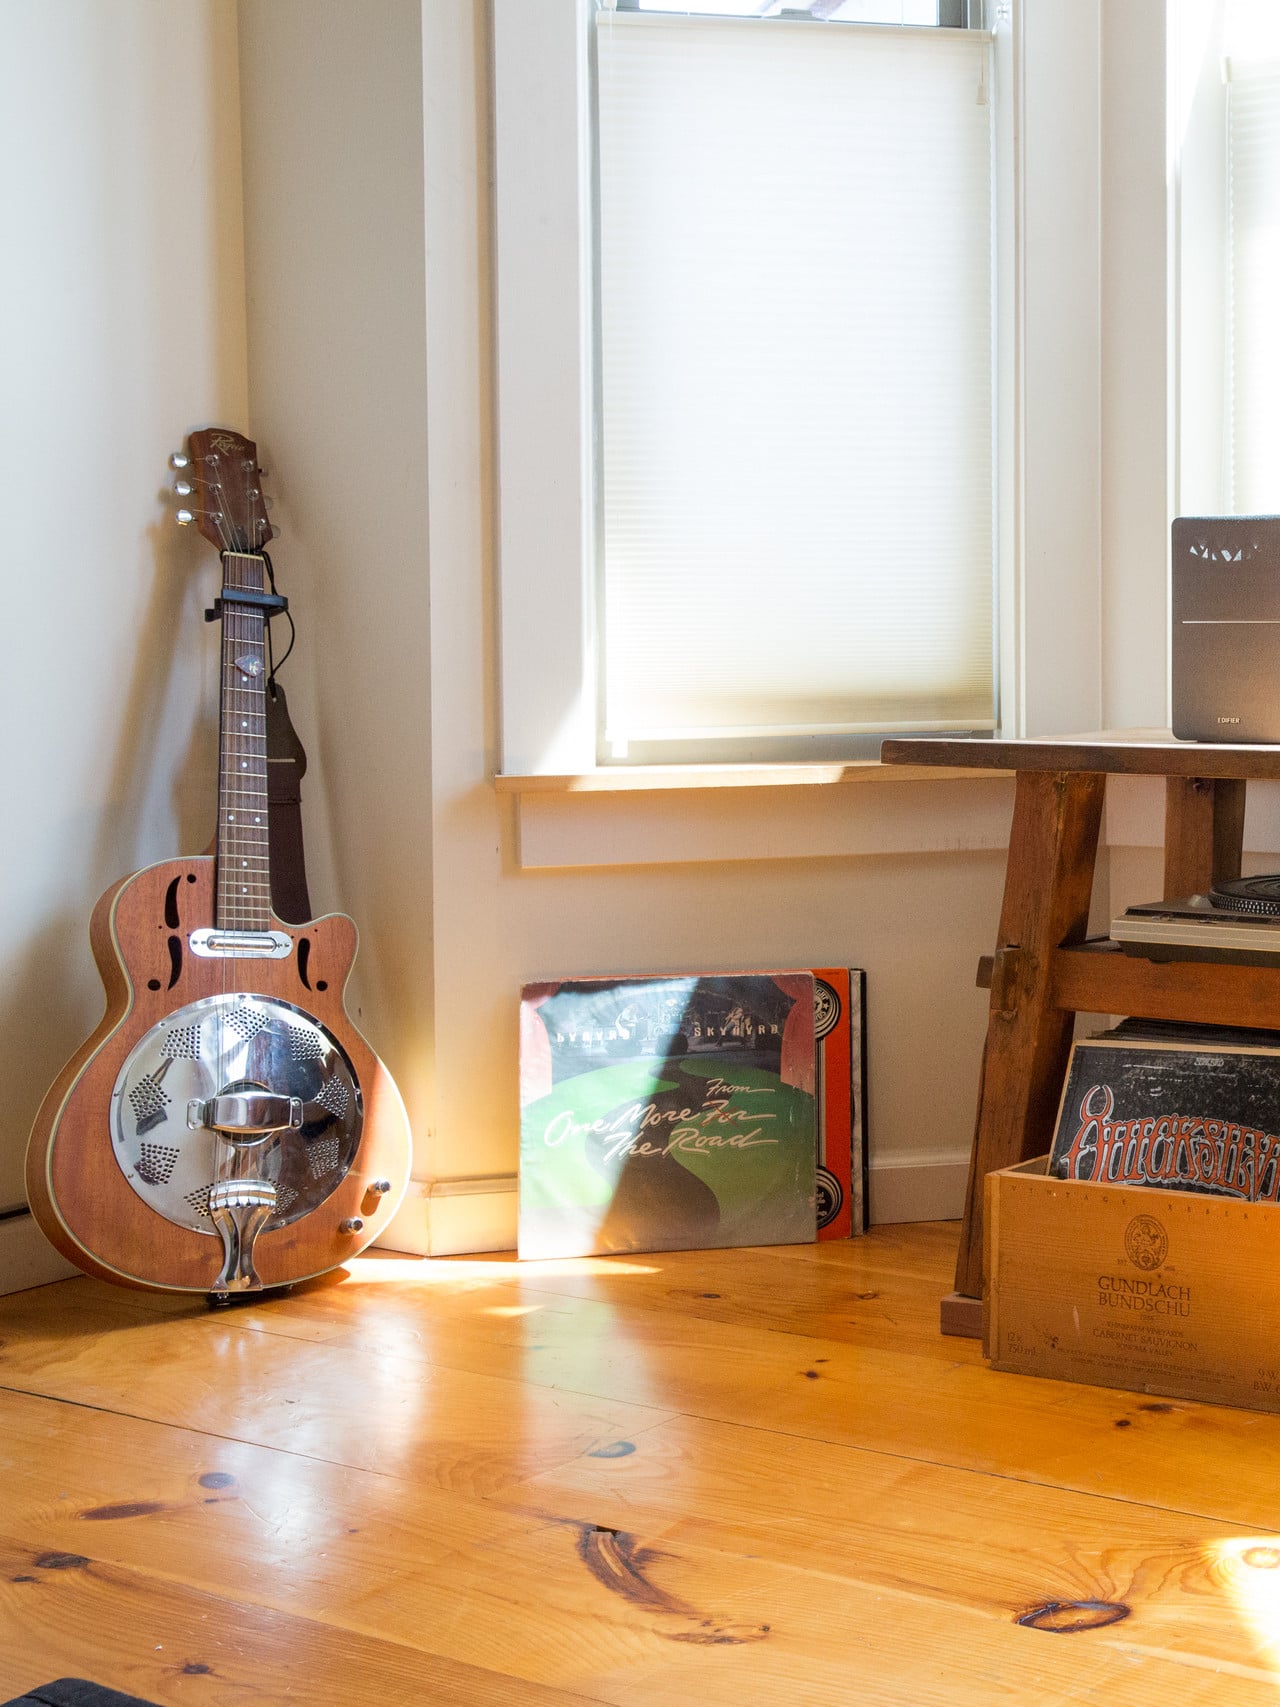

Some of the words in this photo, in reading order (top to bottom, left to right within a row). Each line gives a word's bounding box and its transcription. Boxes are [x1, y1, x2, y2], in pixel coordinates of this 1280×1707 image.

[706, 1078, 776, 1097] From
[544, 1110, 611, 1147] One
[609, 1103, 700, 1131] More
[603, 1131, 664, 1165] The
[661, 1127, 779, 1156] Road
[1098, 1275, 1191, 1301] GUNDLACH
[1098, 1291, 1191, 1317] BUNDSCHU
[1092, 1328, 1138, 1343] CABERNET
[1141, 1335, 1198, 1352] SAUVIGNON
